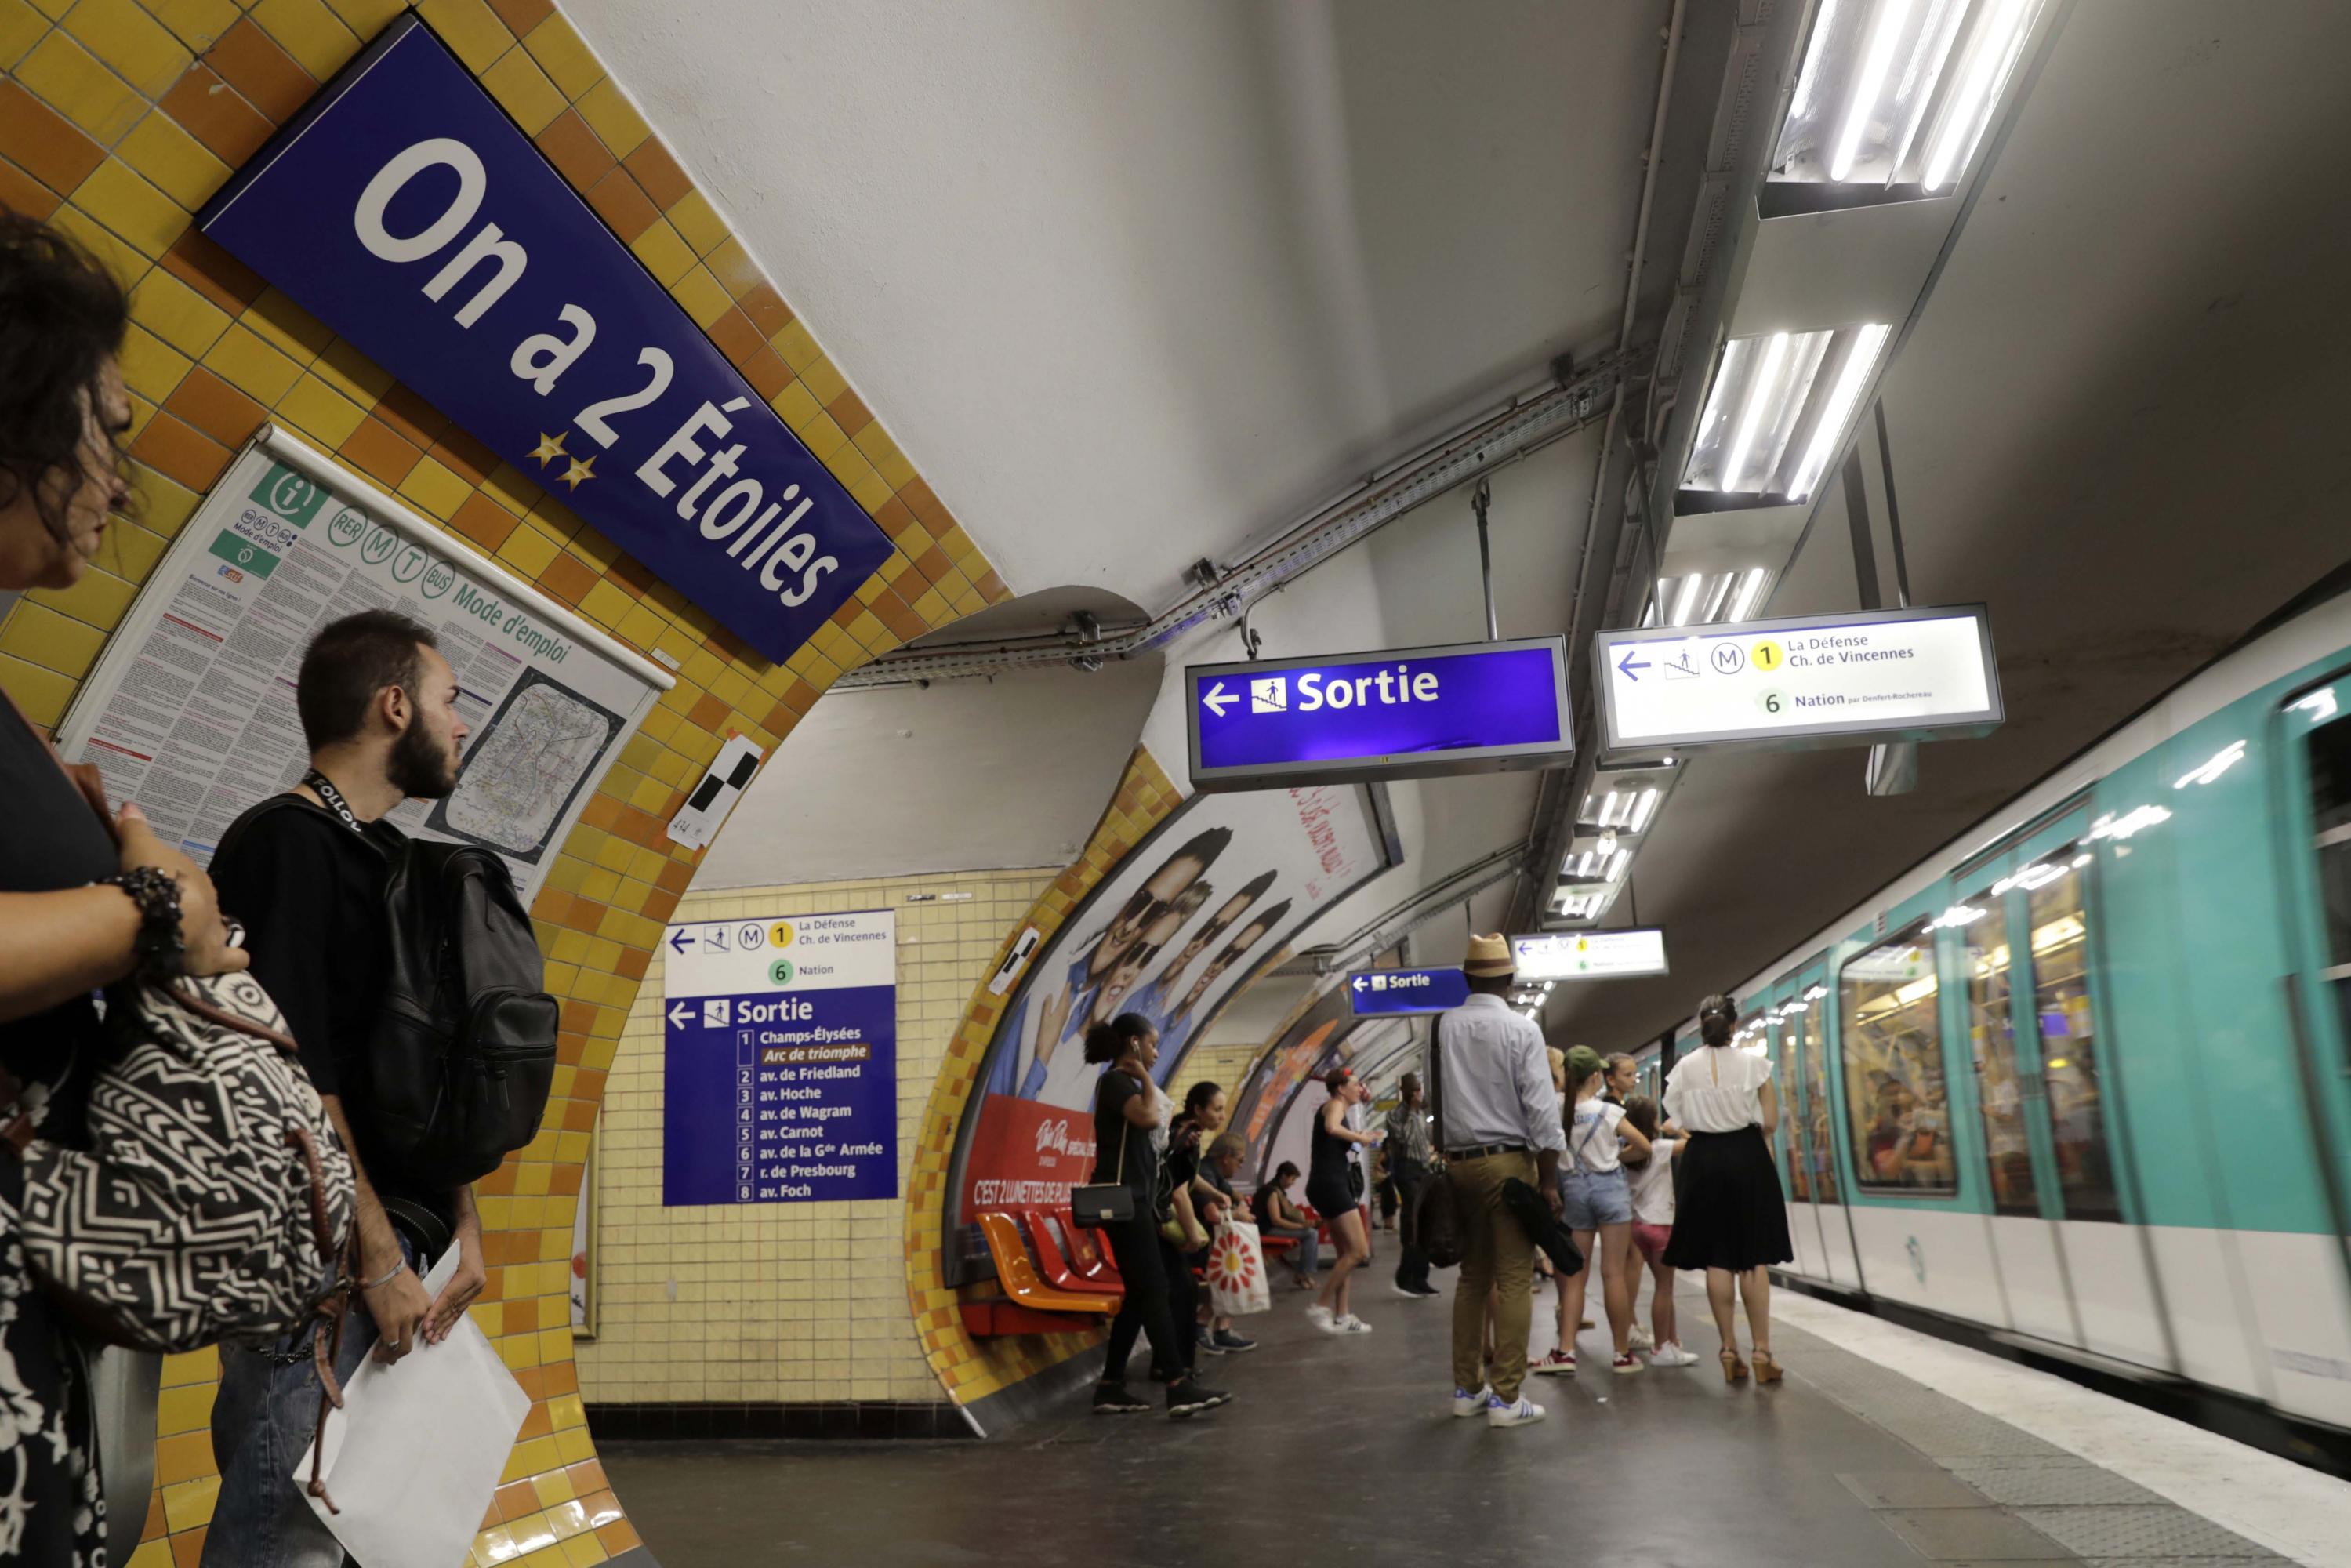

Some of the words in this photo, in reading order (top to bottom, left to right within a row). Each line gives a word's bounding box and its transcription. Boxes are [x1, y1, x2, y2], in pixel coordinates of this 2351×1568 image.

[354, 138, 528, 330] On
[510, 303, 597, 397] a
[573, 347, 674, 450] 2
[634, 396, 839, 608] Étoiles
[234, 522, 254, 538] Mode
[333, 514, 362, 539] RER
[366, 531, 394, 559] M
[401, 551, 423, 574] T
[426, 568, 451, 590] BUS
[452, 583, 503, 626] Mode
[502, 614, 571, 665] d'emploi
[1759, 646, 1772, 665] 1
[1788, 640, 1805, 652] La
[1809, 636, 1869, 650] Défense
[1790, 655, 1812, 667] Ch.
[1817, 653, 1834, 665] de
[1839, 648, 1914, 663] Vincennes
[1297, 664, 1439, 712] Sortie
[1765, 694, 1780, 713] 6
[1795, 693, 1845, 707] Nation
[1862, 691, 1932, 702] Denfert-Rochereau
[775, 928, 785, 942] 1
[799, 922, 811, 931] La
[814, 919, 856, 930] Défense
[799, 935, 815, 945] Ch.
[819, 934, 832, 944] de
[835, 931, 887, 943] Vincennes
[775, 964, 786, 981] 6
[799, 965, 834, 976] Nation
[1389, 974, 1431, 989] Sortie
[737, 996, 814, 1024] Sortie
[741, 1033, 749, 1045] 1
[760, 1026, 862, 1045] Champs-Élysées
[764, 1048, 785, 1062] Arc
[789, 1047, 804, 1061] de
[807, 1045, 866, 1061] triomphe
[741, 1071, 749, 1083] 2
[760, 1072, 778, 1082] av.
[780, 1069, 796, 1081] de
[800, 1065, 861, 1080] Friedland
[741, 1090, 749, 1102] 3
[760, 1091, 778, 1101] av.
[780, 1087, 822, 1100] Hoche
[741, 1109, 749, 1121] 4
[760, 1110, 778, 1120] av.
[780, 1108, 796, 1120] de
[800, 1105, 852, 1121] Wagram
[741, 1128, 749, 1140] 5
[760, 1129, 778, 1139] av.
[780, 1126, 823, 1139] Carnot
[741, 1148, 749, 1160] 6
[760, 1149, 778, 1159] av.
[780, 1146, 796, 1158] de
[800, 1145, 811, 1157] la
[840, 1142, 883, 1156] Armée
[741, 1167, 749, 1179] 7
[760, 1168, 768, 1178] r.
[771, 1166, 787, 1178] de
[790, 1163, 856, 1178] Presbourg
[741, 1186, 749, 1199] 8
[760, 1187, 778, 1198] av.
[780, 1184, 811, 1198] Foch
[974, 1179, 1000, 1206] C'EST
[998, 1180, 1007, 1204] 2
[1005, 1180, 1045, 1204] LUNETTES
